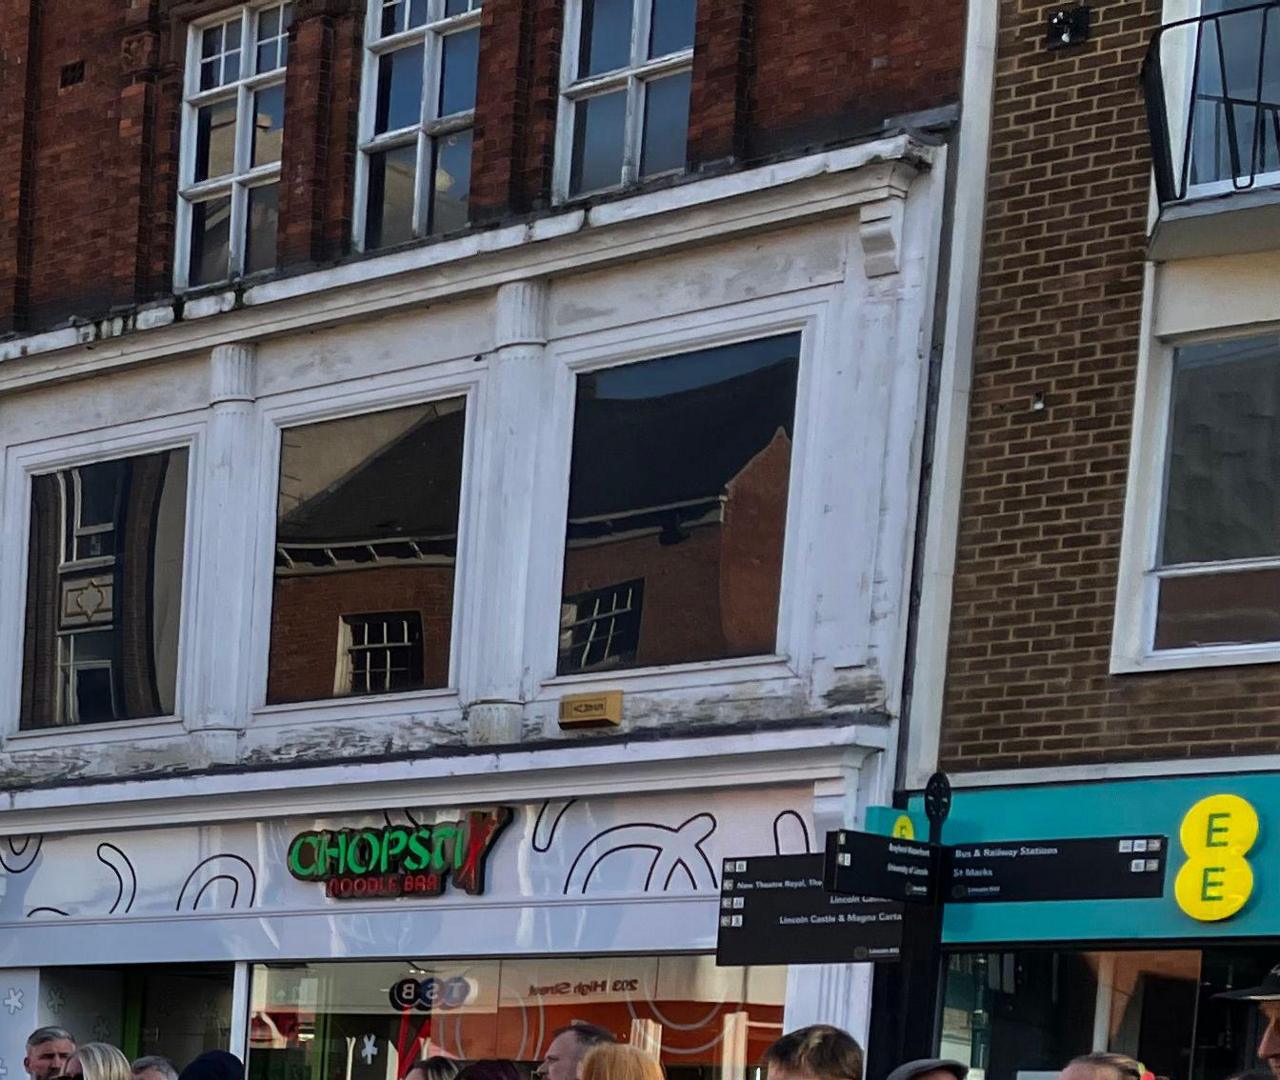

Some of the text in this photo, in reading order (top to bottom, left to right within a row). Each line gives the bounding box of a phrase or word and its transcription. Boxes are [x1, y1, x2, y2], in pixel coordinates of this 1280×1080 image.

[290, 808, 504, 892] CHOPSTIX
[955, 849, 972, 858] Bus
[983, 848, 1018, 858] Railway
[1020, 846, 1058, 855] Stations
[329, 875, 439, 896] NOODLE BAR
[830, 895, 860, 904] Lincoln
[780, 915, 809, 925] Lincoln
[810, 914, 836, 924] Castle
[847, 913, 876, 924] Magna
[878, 911, 902, 921] Carta
